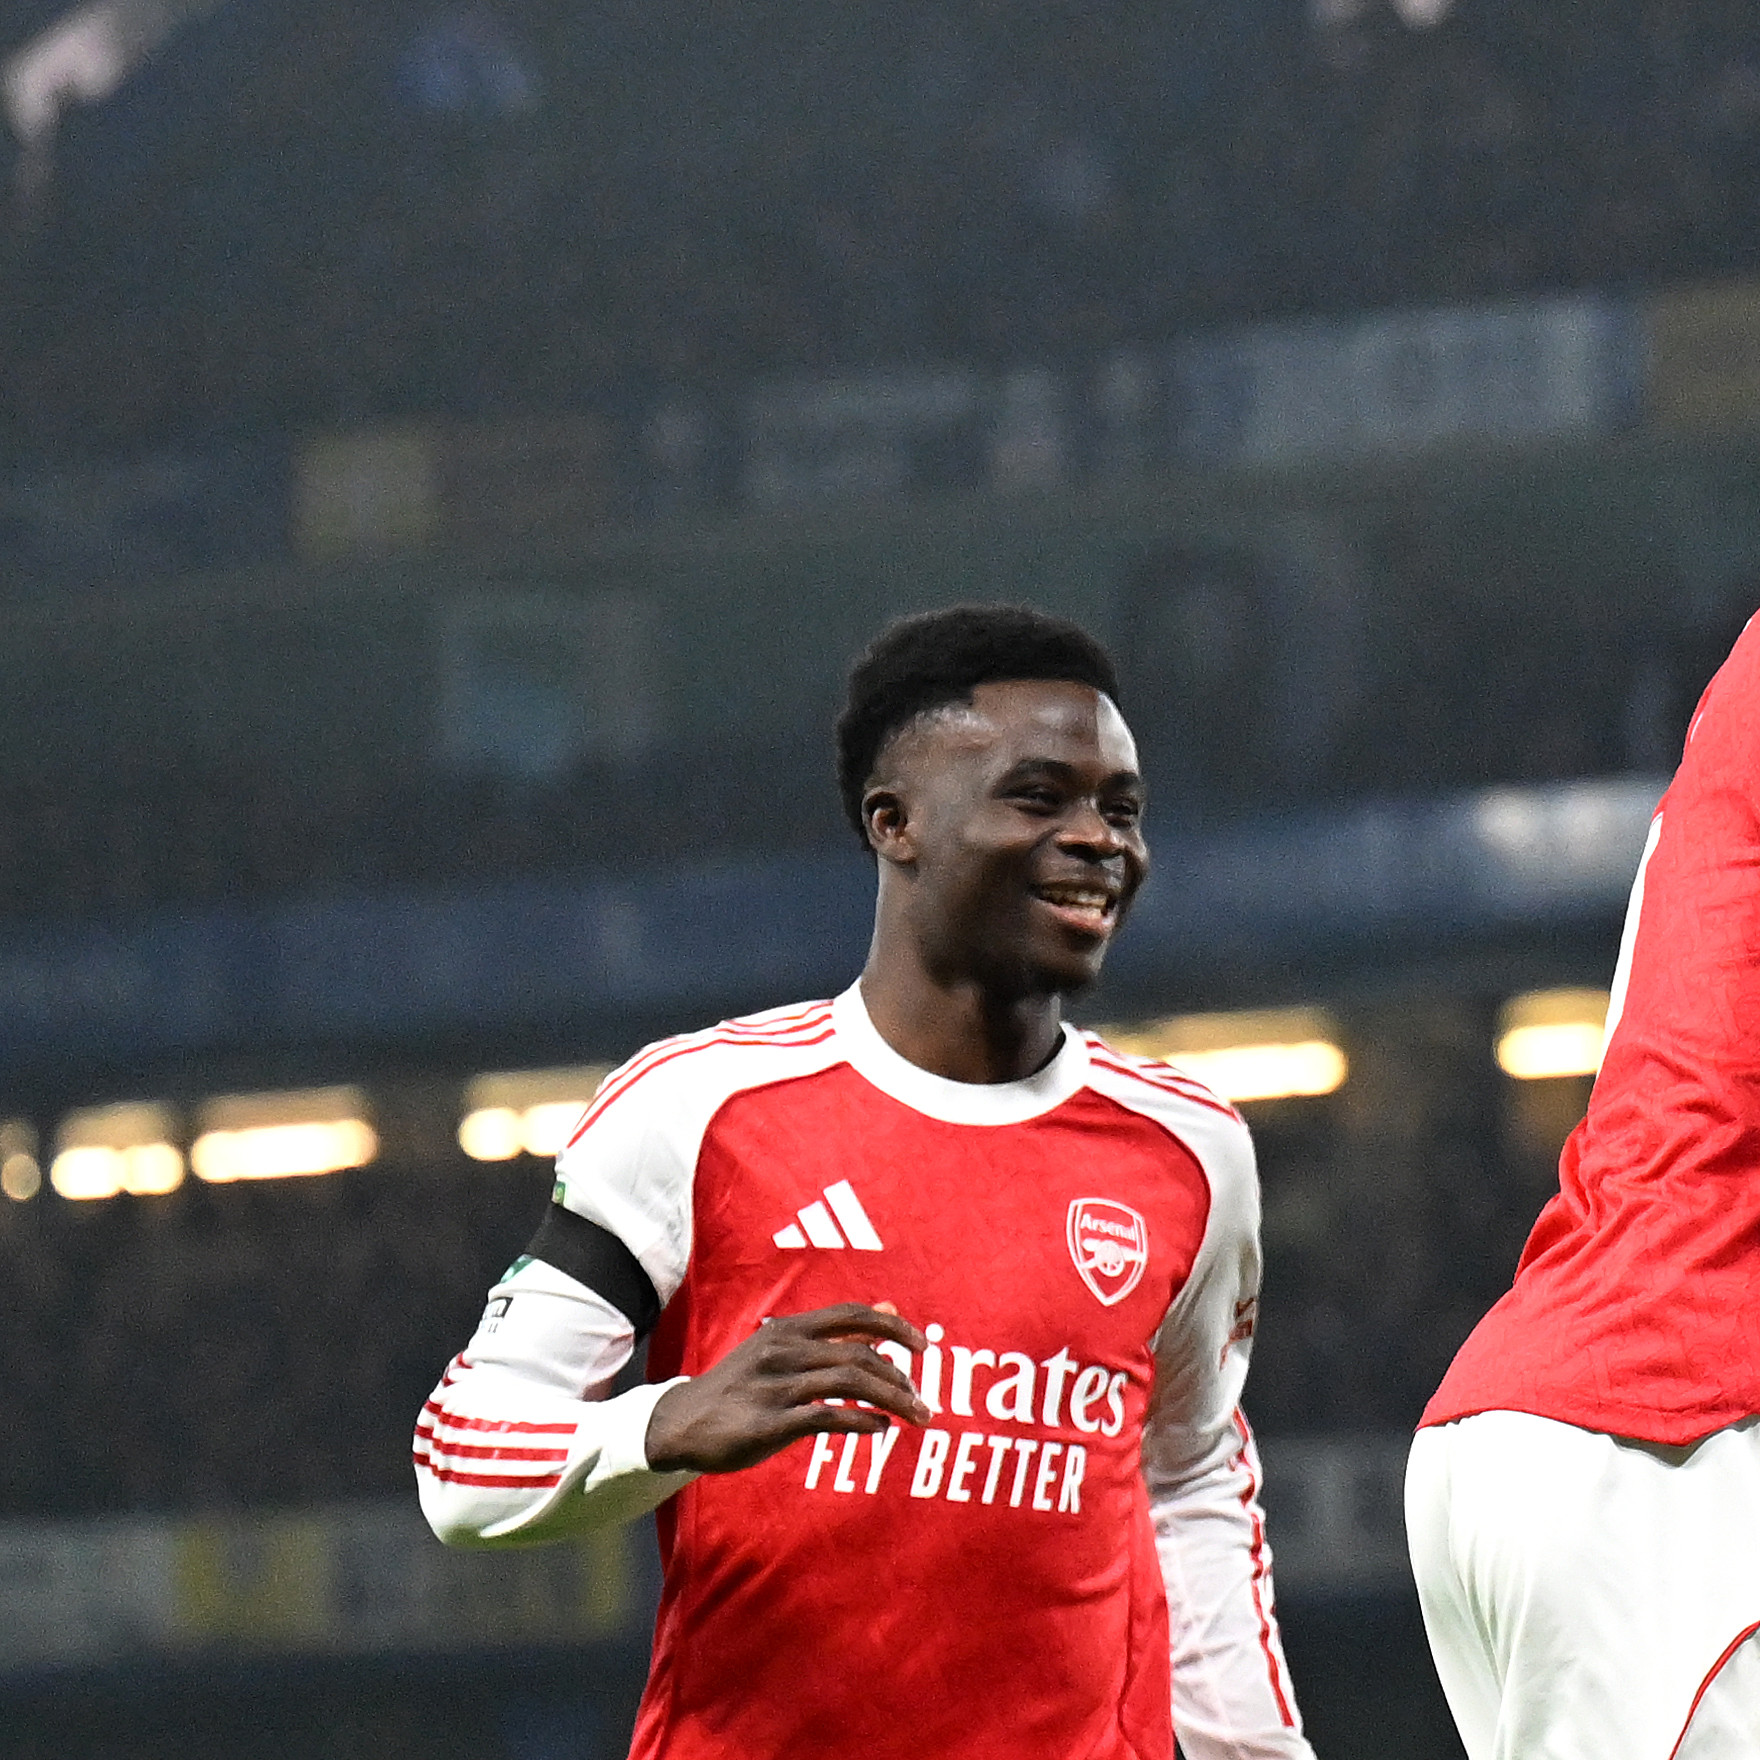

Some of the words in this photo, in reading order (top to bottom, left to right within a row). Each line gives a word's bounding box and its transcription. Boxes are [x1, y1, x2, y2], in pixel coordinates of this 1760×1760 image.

[1080, 1213, 1137, 1242] Arsenal
[866, 1323, 1129, 1437] irates
[804, 1426, 901, 1495] FLY
[909, 1428, 1087, 1515] BETTER
